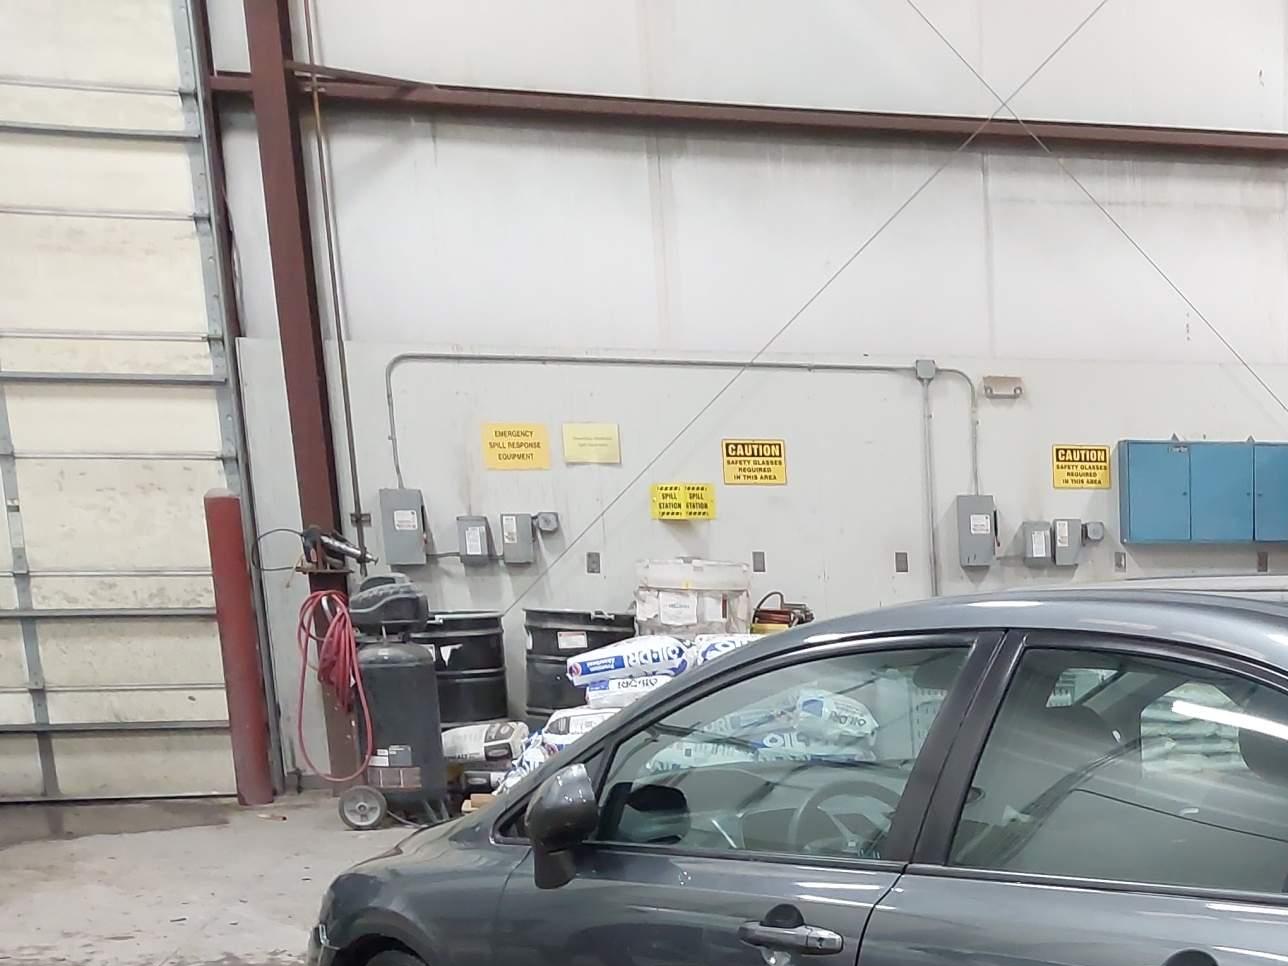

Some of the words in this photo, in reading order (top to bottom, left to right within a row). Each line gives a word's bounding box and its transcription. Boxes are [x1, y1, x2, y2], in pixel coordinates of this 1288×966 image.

[494, 430, 534, 438] EMERGENCY
[488, 441, 506, 449] SPILL
[507, 441, 541, 449] RESPONSE
[728, 444, 780, 456] CAUTION
[498, 453, 534, 461] EQUIPMENT
[1058, 449, 1105, 461] CAUTION
[661, 492, 678, 500] SPILL
[688, 492, 704, 500] SPILL
